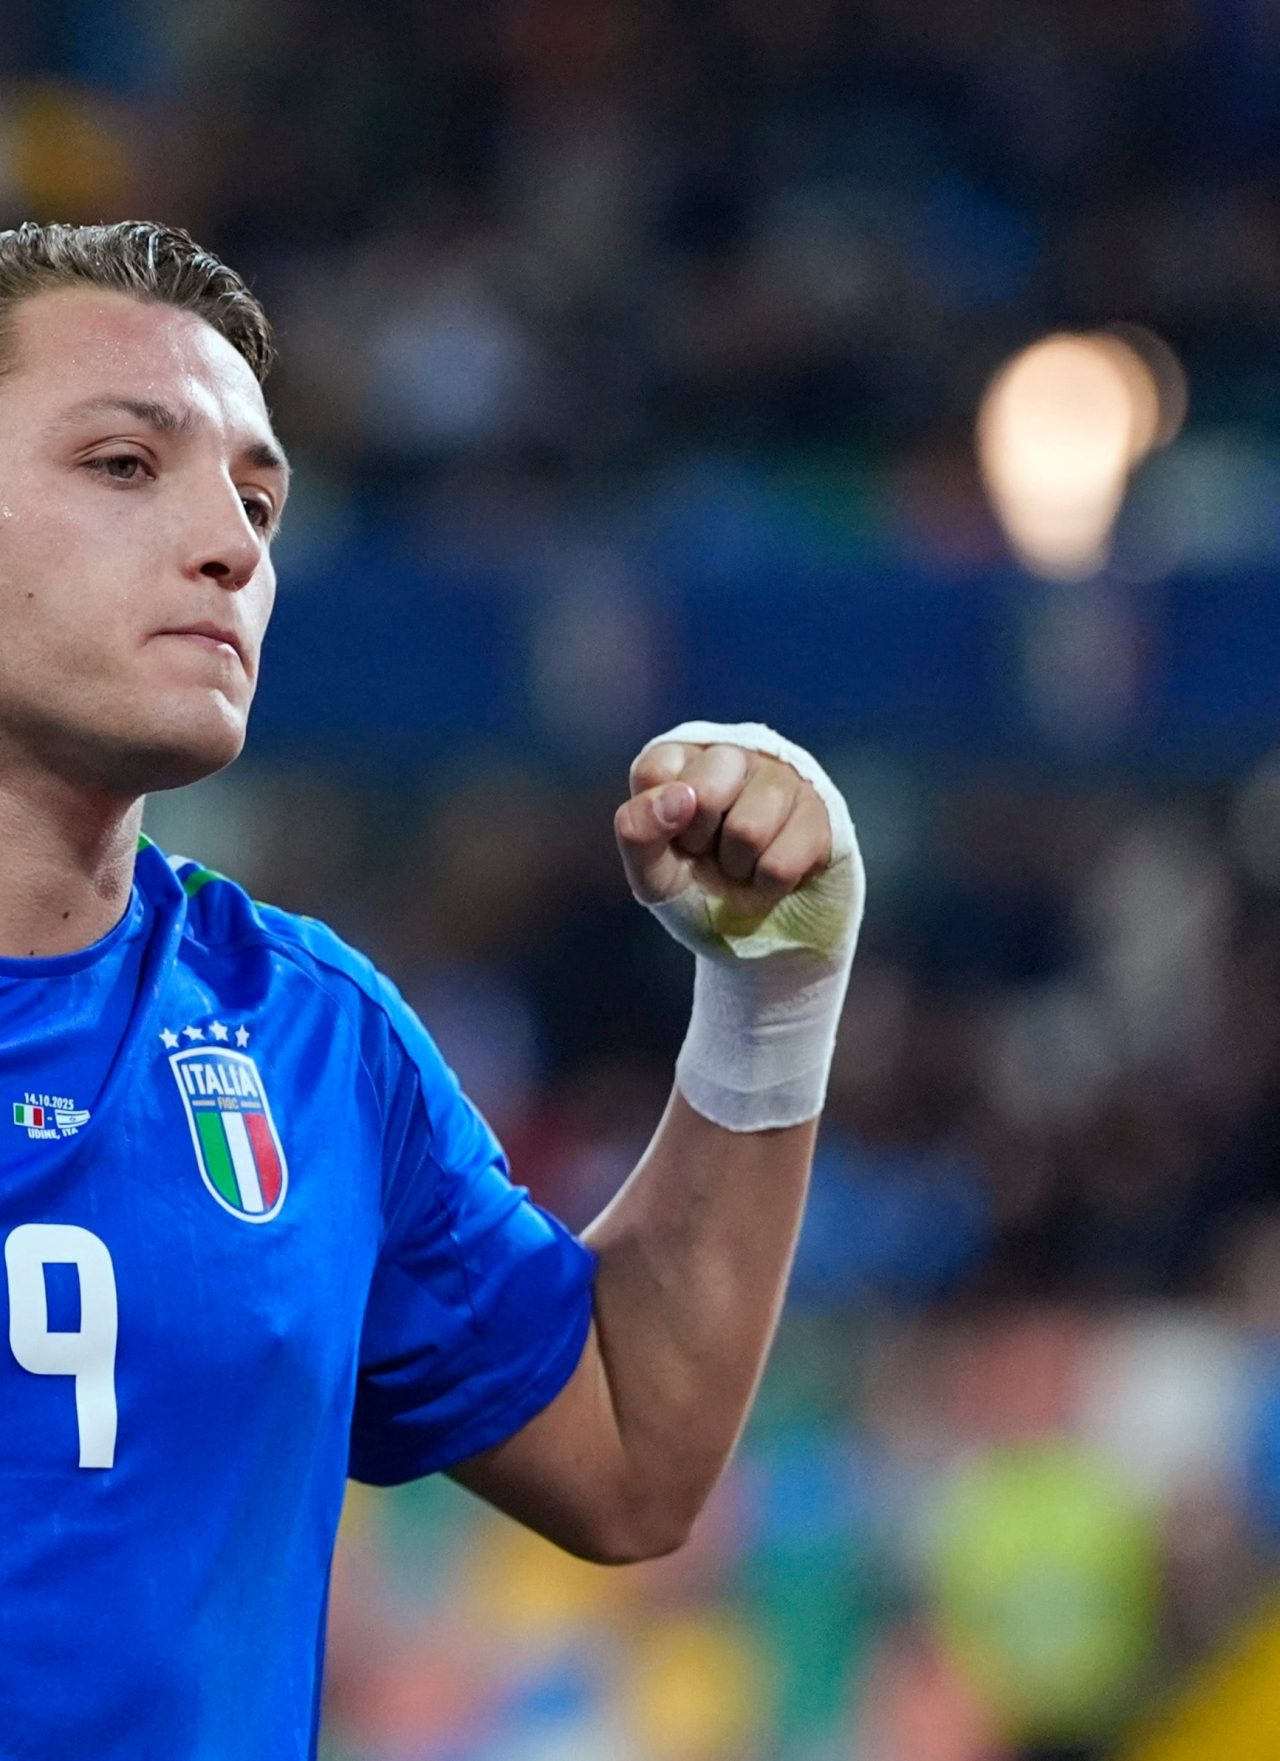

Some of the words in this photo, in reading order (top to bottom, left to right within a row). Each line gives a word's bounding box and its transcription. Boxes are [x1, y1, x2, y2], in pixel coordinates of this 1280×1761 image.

[181, 1064, 258, 1097] ITALIA
[24, 1092, 74, 1110] 14.10.2025
[27, 1128, 61, 1140] UDINE,
[4, 1223, 118, 1468] 9
